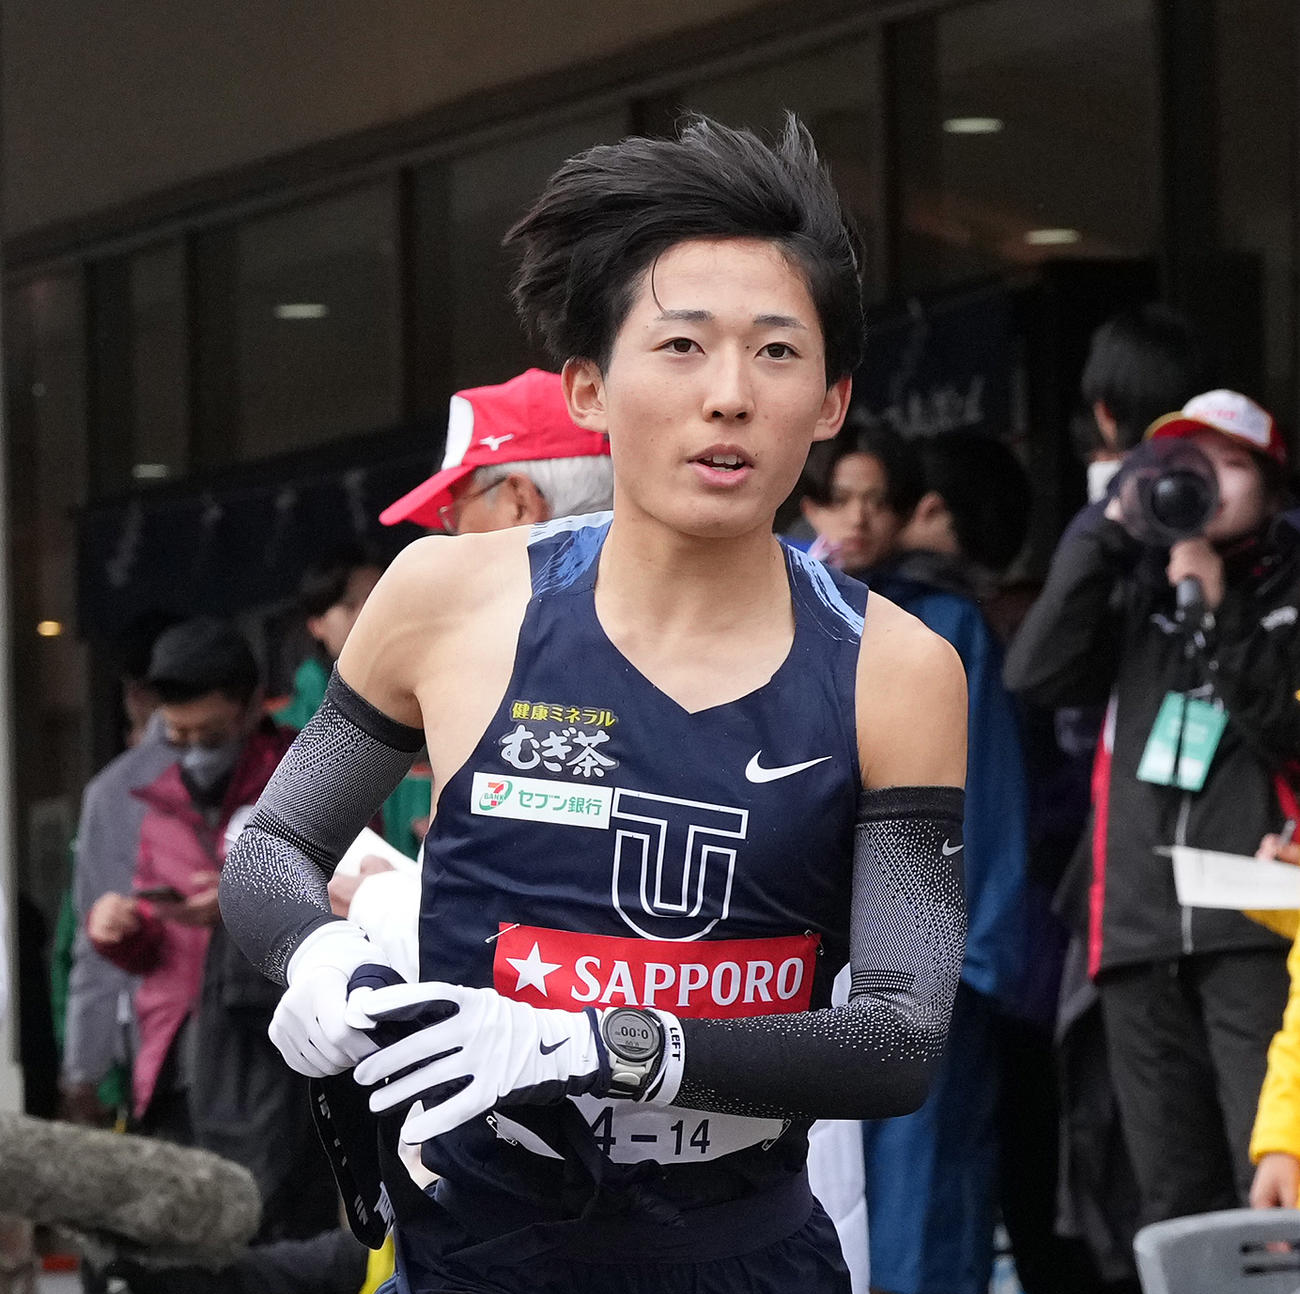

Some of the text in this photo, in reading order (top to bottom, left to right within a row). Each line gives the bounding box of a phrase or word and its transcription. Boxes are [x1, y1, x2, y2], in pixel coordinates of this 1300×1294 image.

[511, 702, 616, 727] 健康ミネラル
[500, 724, 616, 778] むぎ茶
[518, 789, 603, 816] セブン銀行
[570, 955, 804, 1007] SAPPORO
[669, 1027, 681, 1062] LEFT
